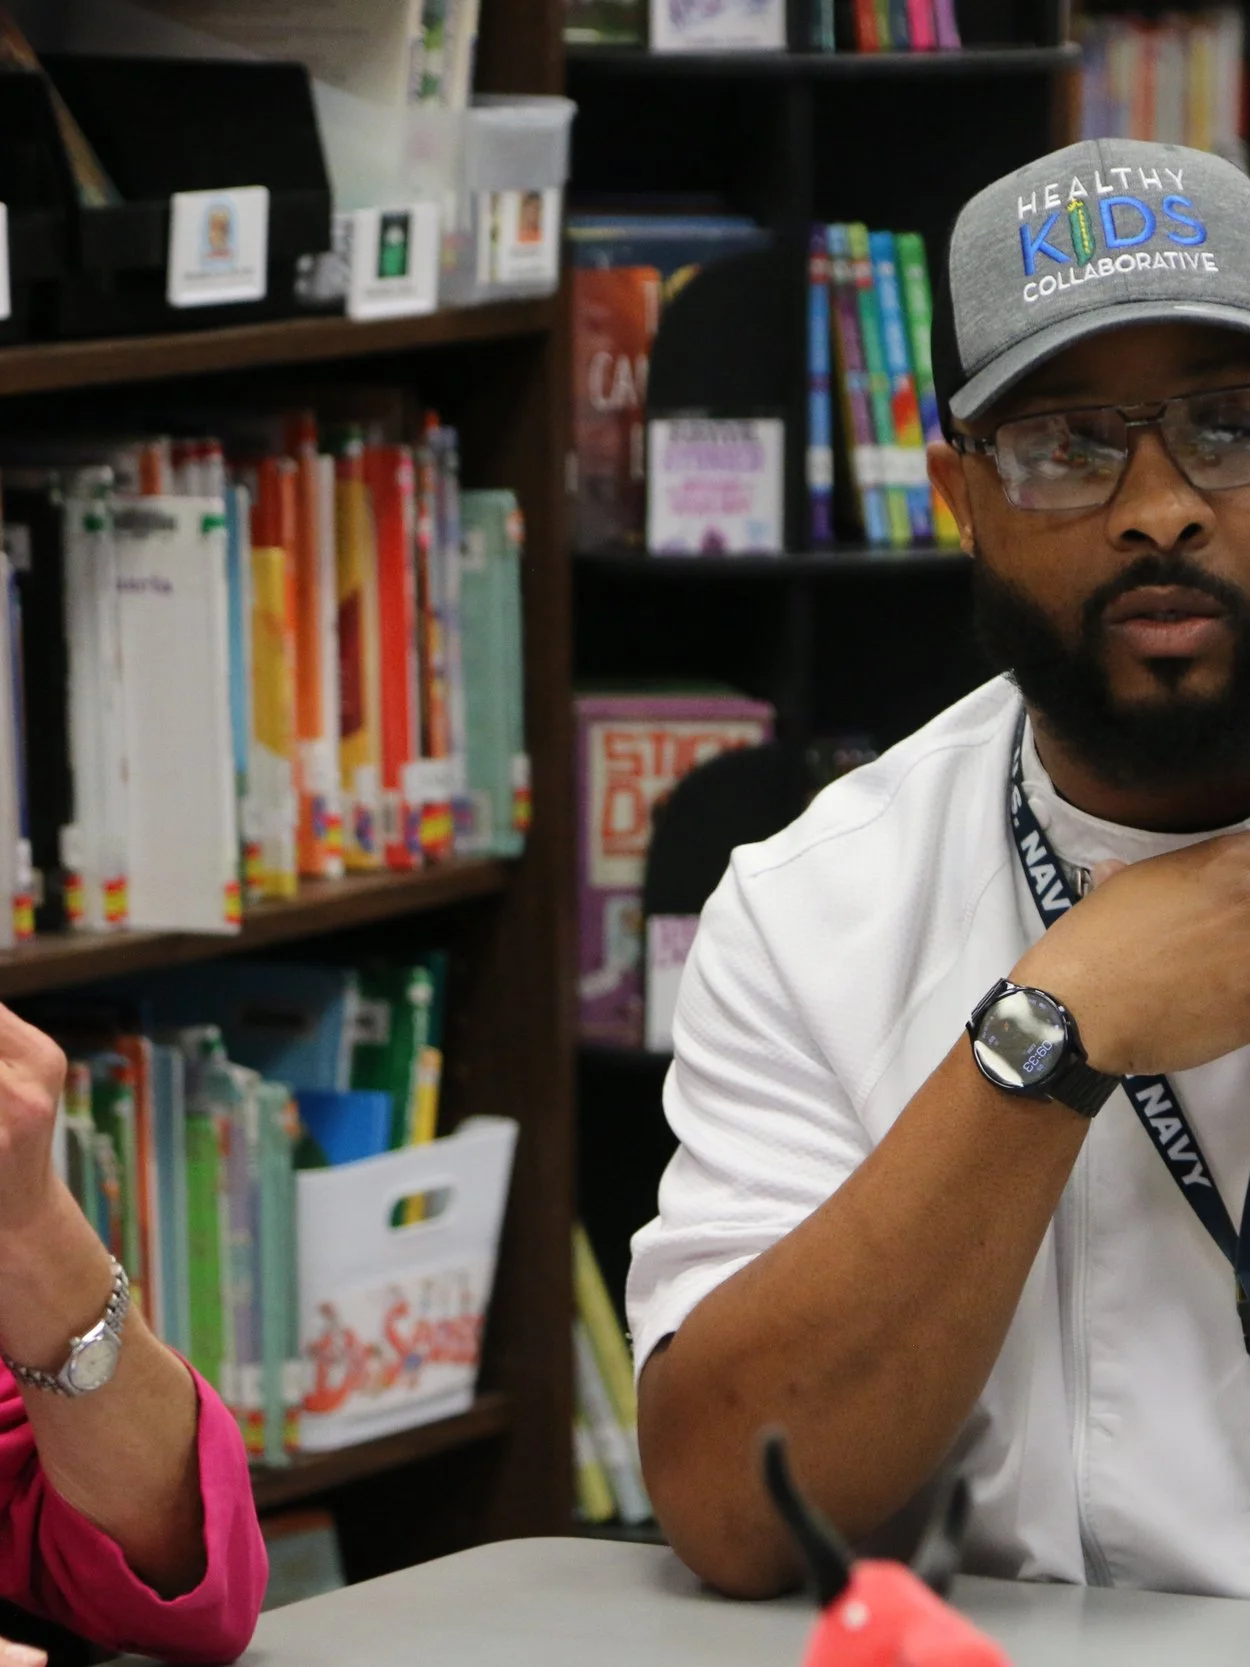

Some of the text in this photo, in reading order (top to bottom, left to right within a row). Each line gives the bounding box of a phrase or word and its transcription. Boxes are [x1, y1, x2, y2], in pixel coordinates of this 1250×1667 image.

[1018, 167, 1184, 219] HEALTHY
[1019, 193, 1208, 277] KIDS
[1023, 251, 1219, 302] COLLABORATIVE
[1020, 829, 1073, 911] NAV
[1135, 1083, 1213, 1187] NAVY
